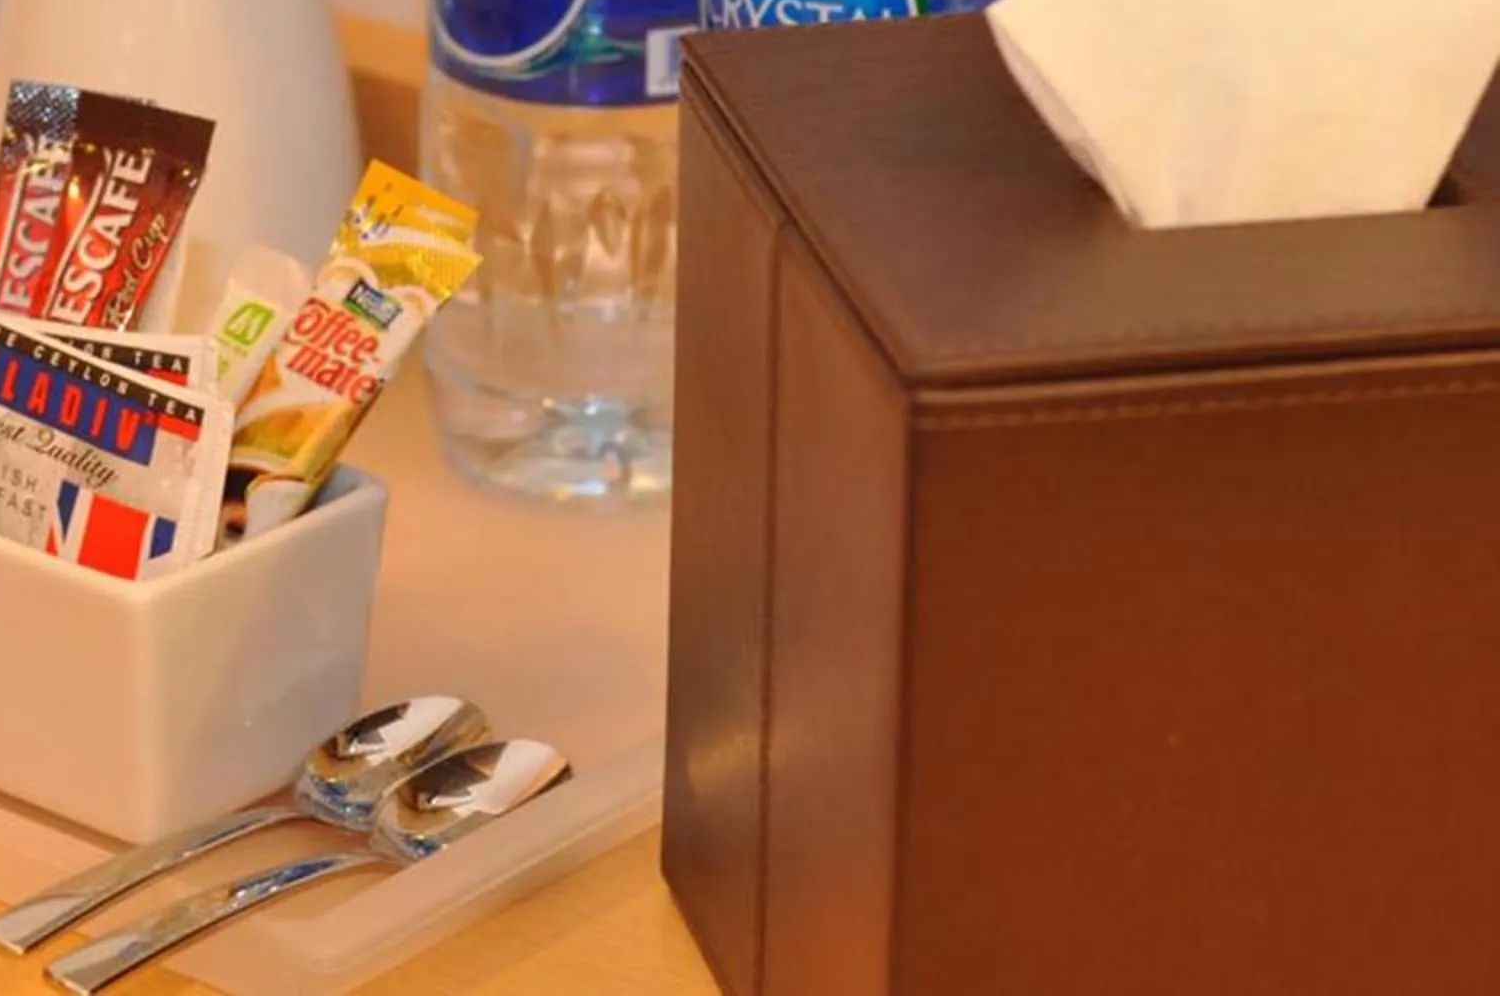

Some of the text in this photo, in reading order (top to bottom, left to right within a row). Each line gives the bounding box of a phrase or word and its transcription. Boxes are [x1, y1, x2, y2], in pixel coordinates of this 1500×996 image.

[131, 212, 169, 271] Cup
[32, 345, 130, 396] CEYLON
[146, 394, 197, 422] TEA
[134, 351, 184, 372] TEA
[285, 346, 379, 406] mate
[25, 426, 119, 490] Quality
